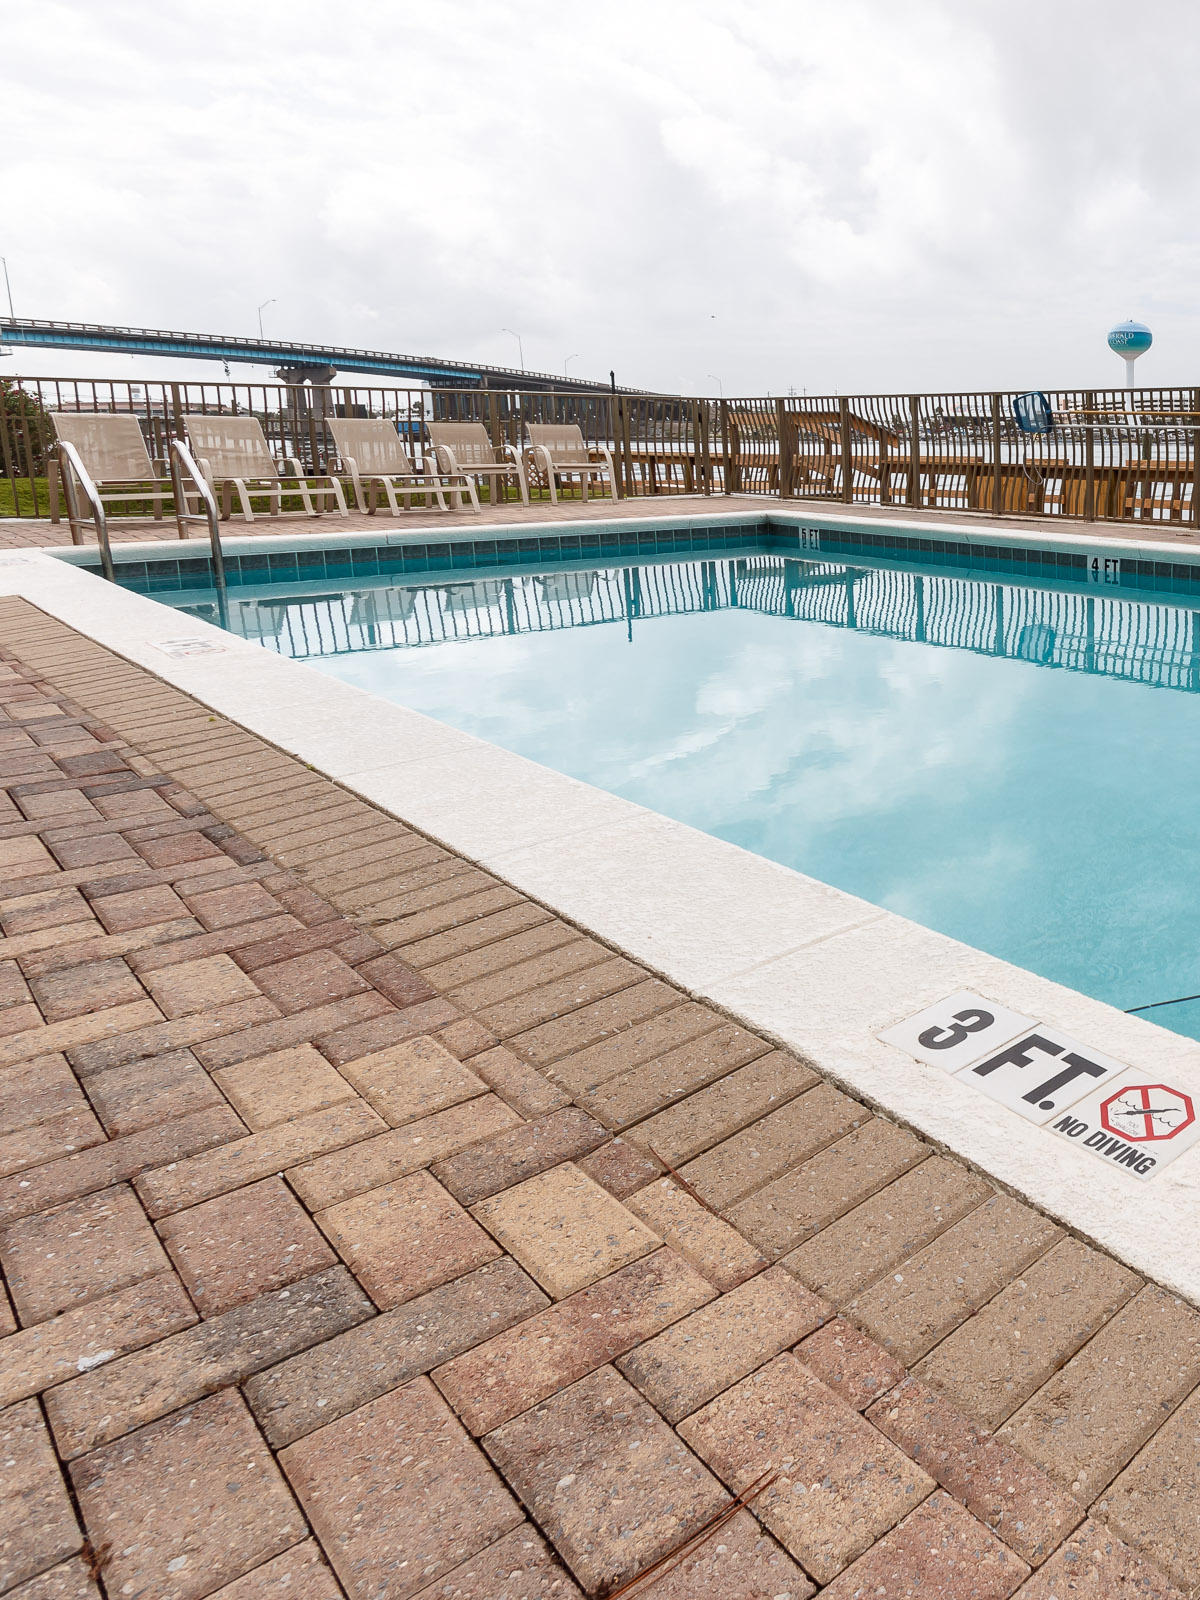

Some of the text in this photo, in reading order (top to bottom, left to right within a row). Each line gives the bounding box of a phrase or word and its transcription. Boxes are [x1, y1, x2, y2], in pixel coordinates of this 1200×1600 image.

[1092, 558, 1118, 573] 4 FT
[917, 1008, 1109, 1111] 3 FT.
[1053, 1115, 1157, 1175] NO DIVING
